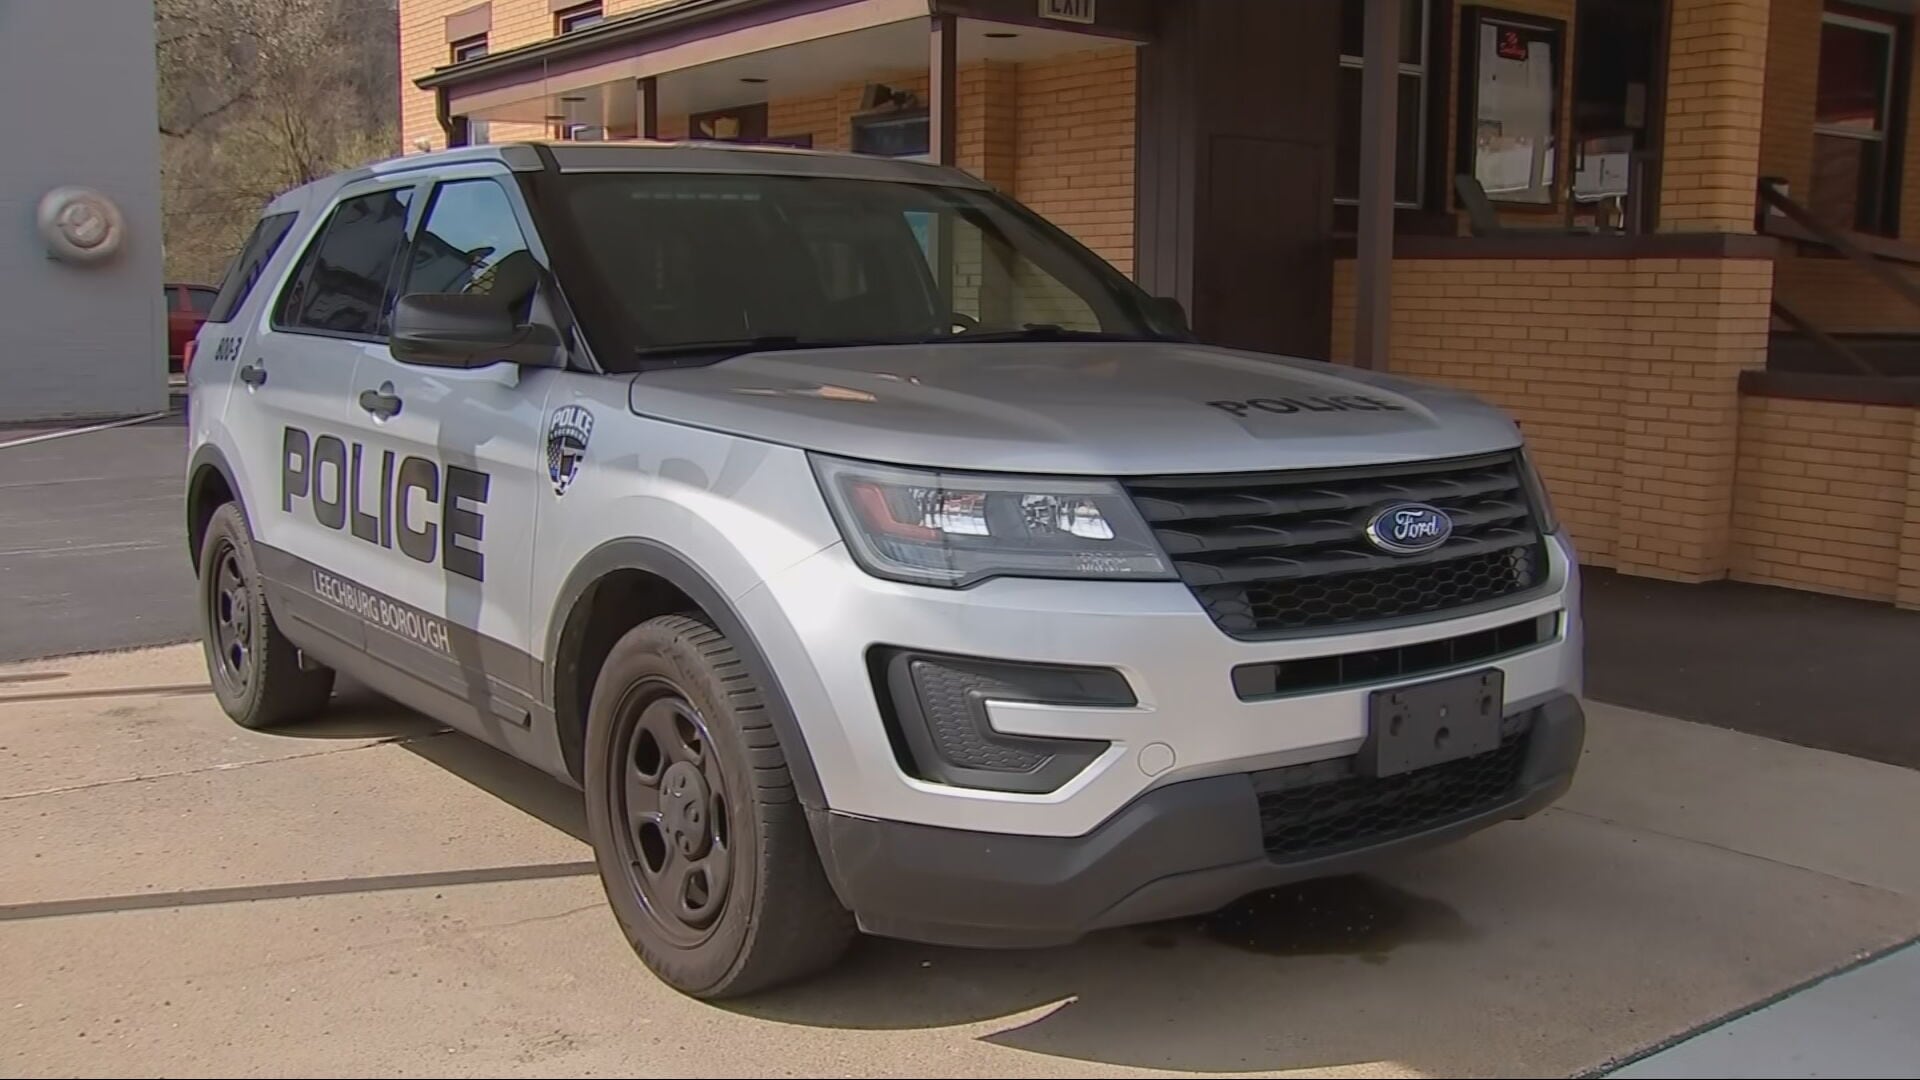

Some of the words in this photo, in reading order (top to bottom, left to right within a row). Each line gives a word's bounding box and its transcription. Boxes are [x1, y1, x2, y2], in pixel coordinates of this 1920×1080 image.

[1206, 395, 1406, 418] POLICE
[551, 407, 593, 437] POLICE
[281, 425, 490, 582] POLICE
[1394, 510, 1439, 540] Ford
[312, 569, 380, 621] LEECHBURG
[379, 599, 451, 653] BOROUGH
